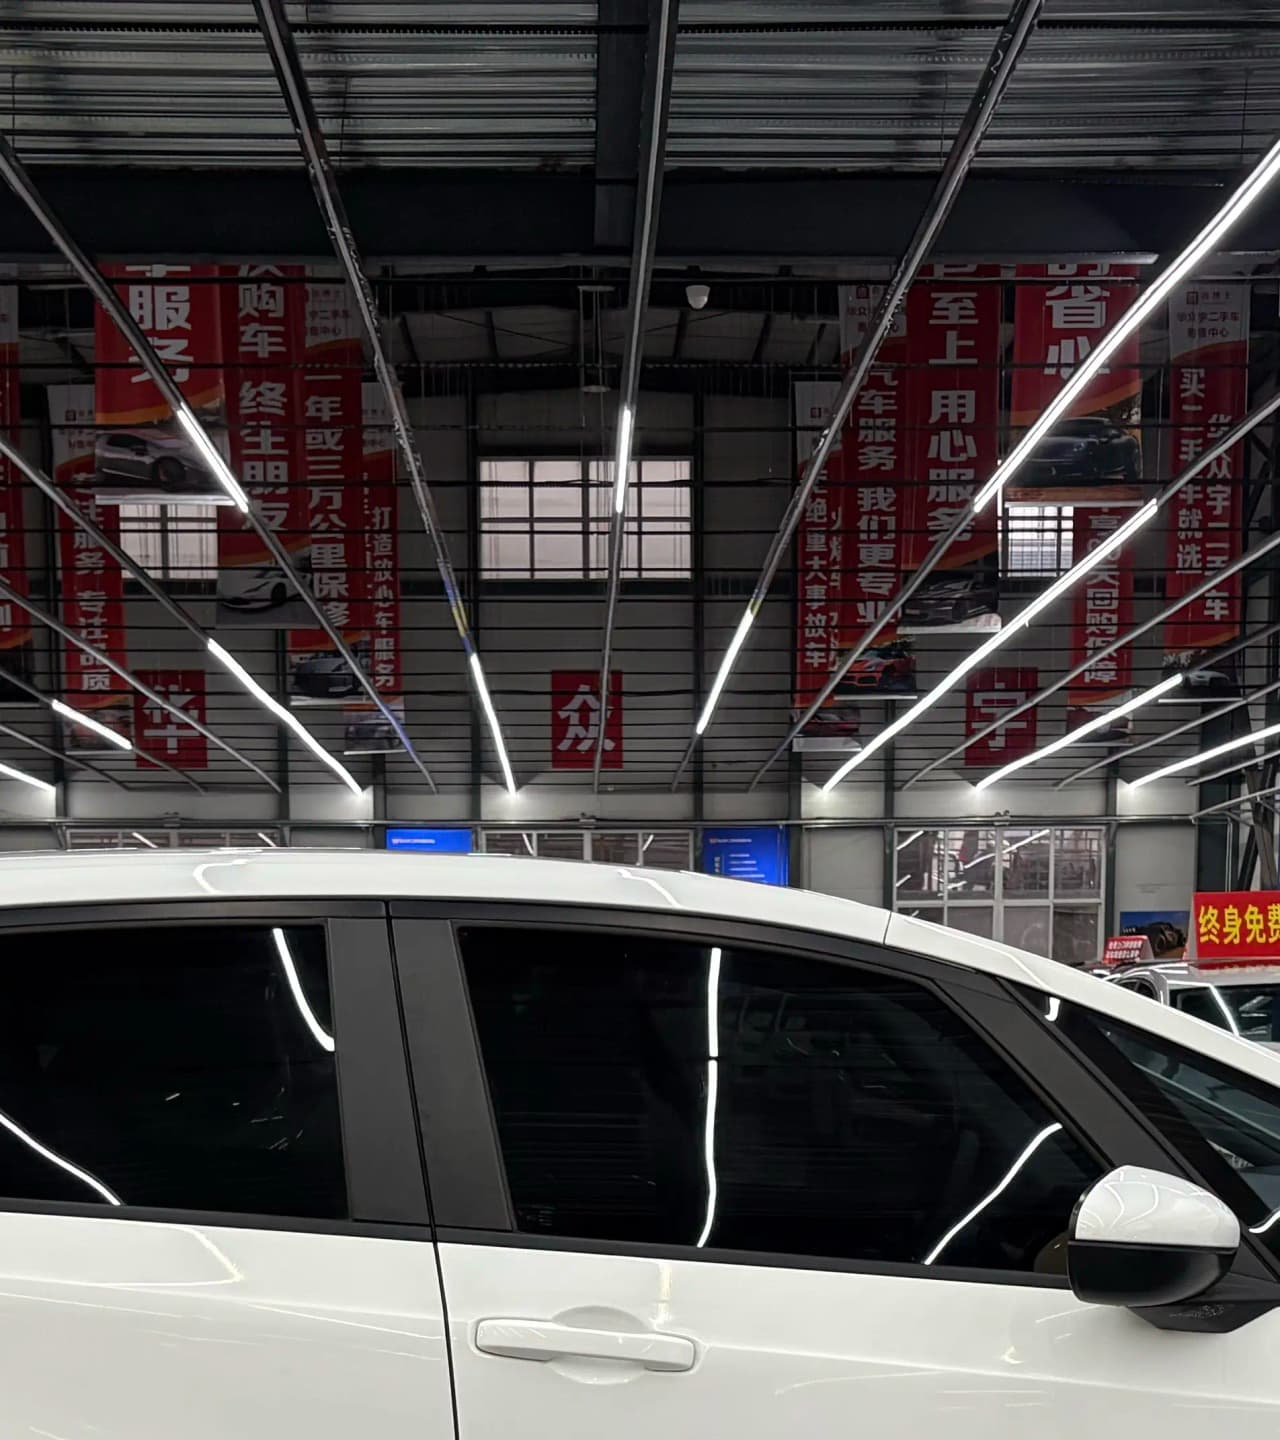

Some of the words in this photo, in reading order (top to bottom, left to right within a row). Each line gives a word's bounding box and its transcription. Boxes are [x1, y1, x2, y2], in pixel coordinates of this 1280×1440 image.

[238, 380, 291, 530] 终生朋友
[926, 389, 980, 542] 用心服务
[557, 686, 616, 754] 众
[971, 684, 1026, 750] 宇
